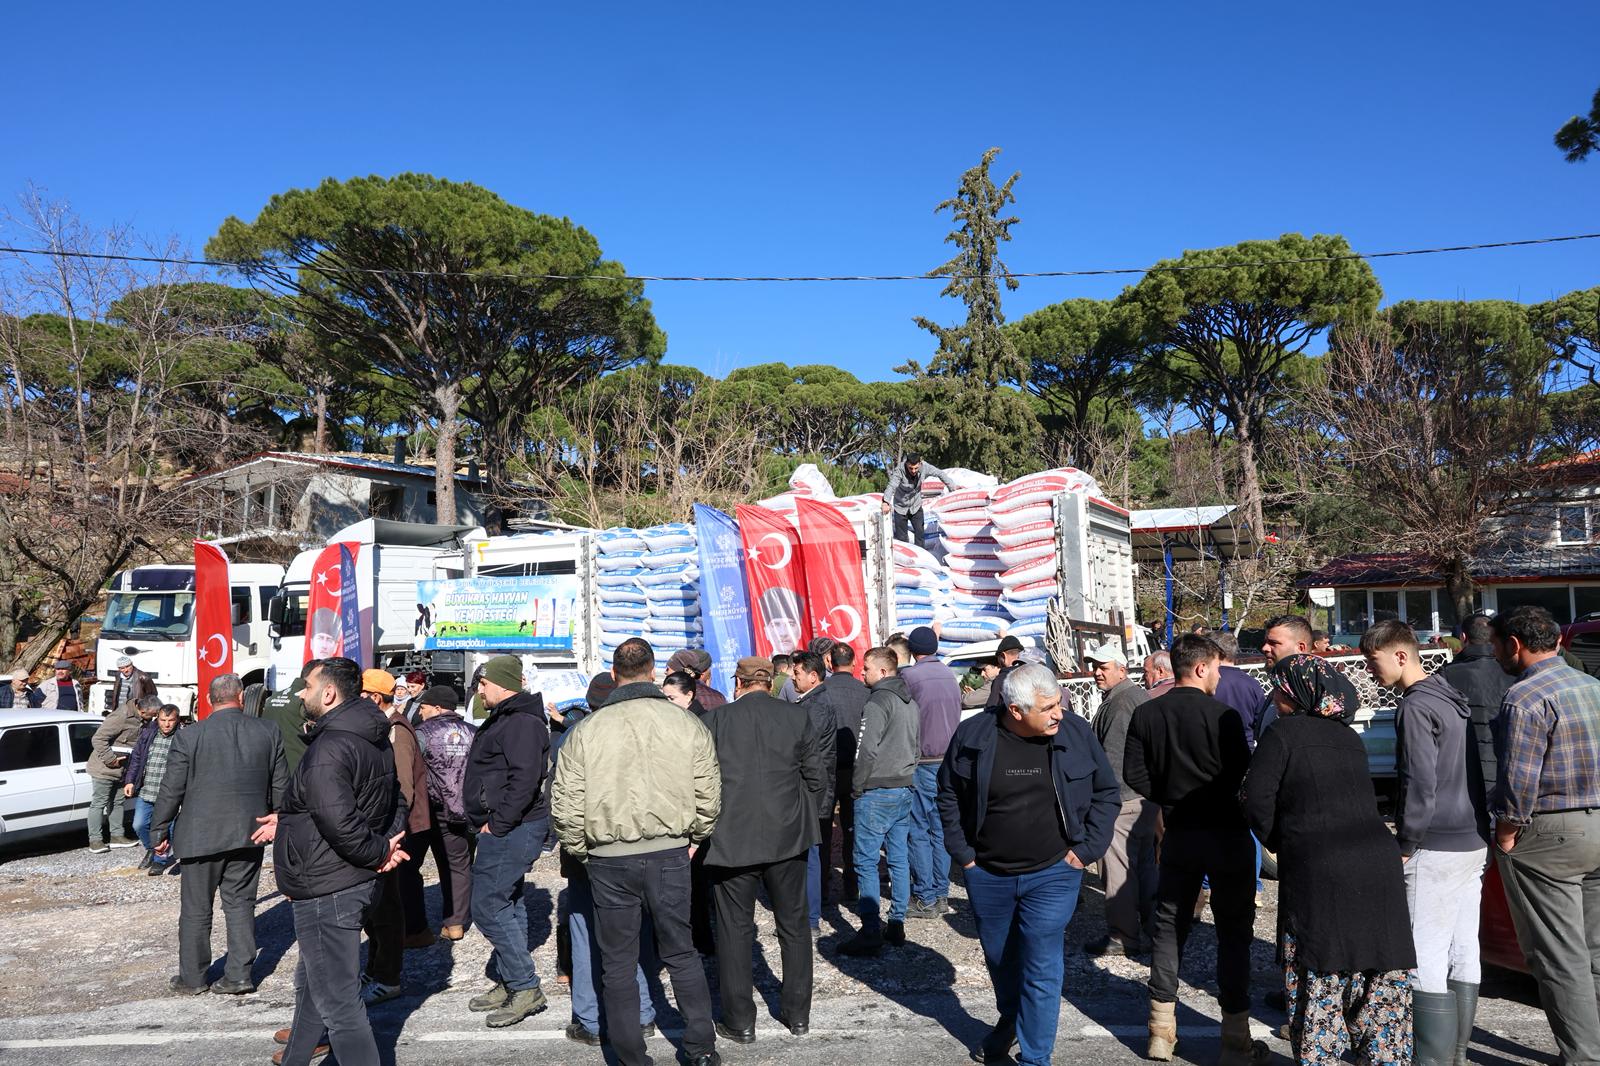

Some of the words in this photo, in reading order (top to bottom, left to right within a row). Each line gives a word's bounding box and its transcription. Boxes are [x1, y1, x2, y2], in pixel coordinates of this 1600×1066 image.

[445, 591, 491, 608] BÜYÜKBAŞ
[491, 591, 529, 606] HAYVAN
[455, 609, 475, 623] YEM
[476, 607, 517, 623] DESTEĞİ
[436, 639, 455, 648] ÖZLEM
